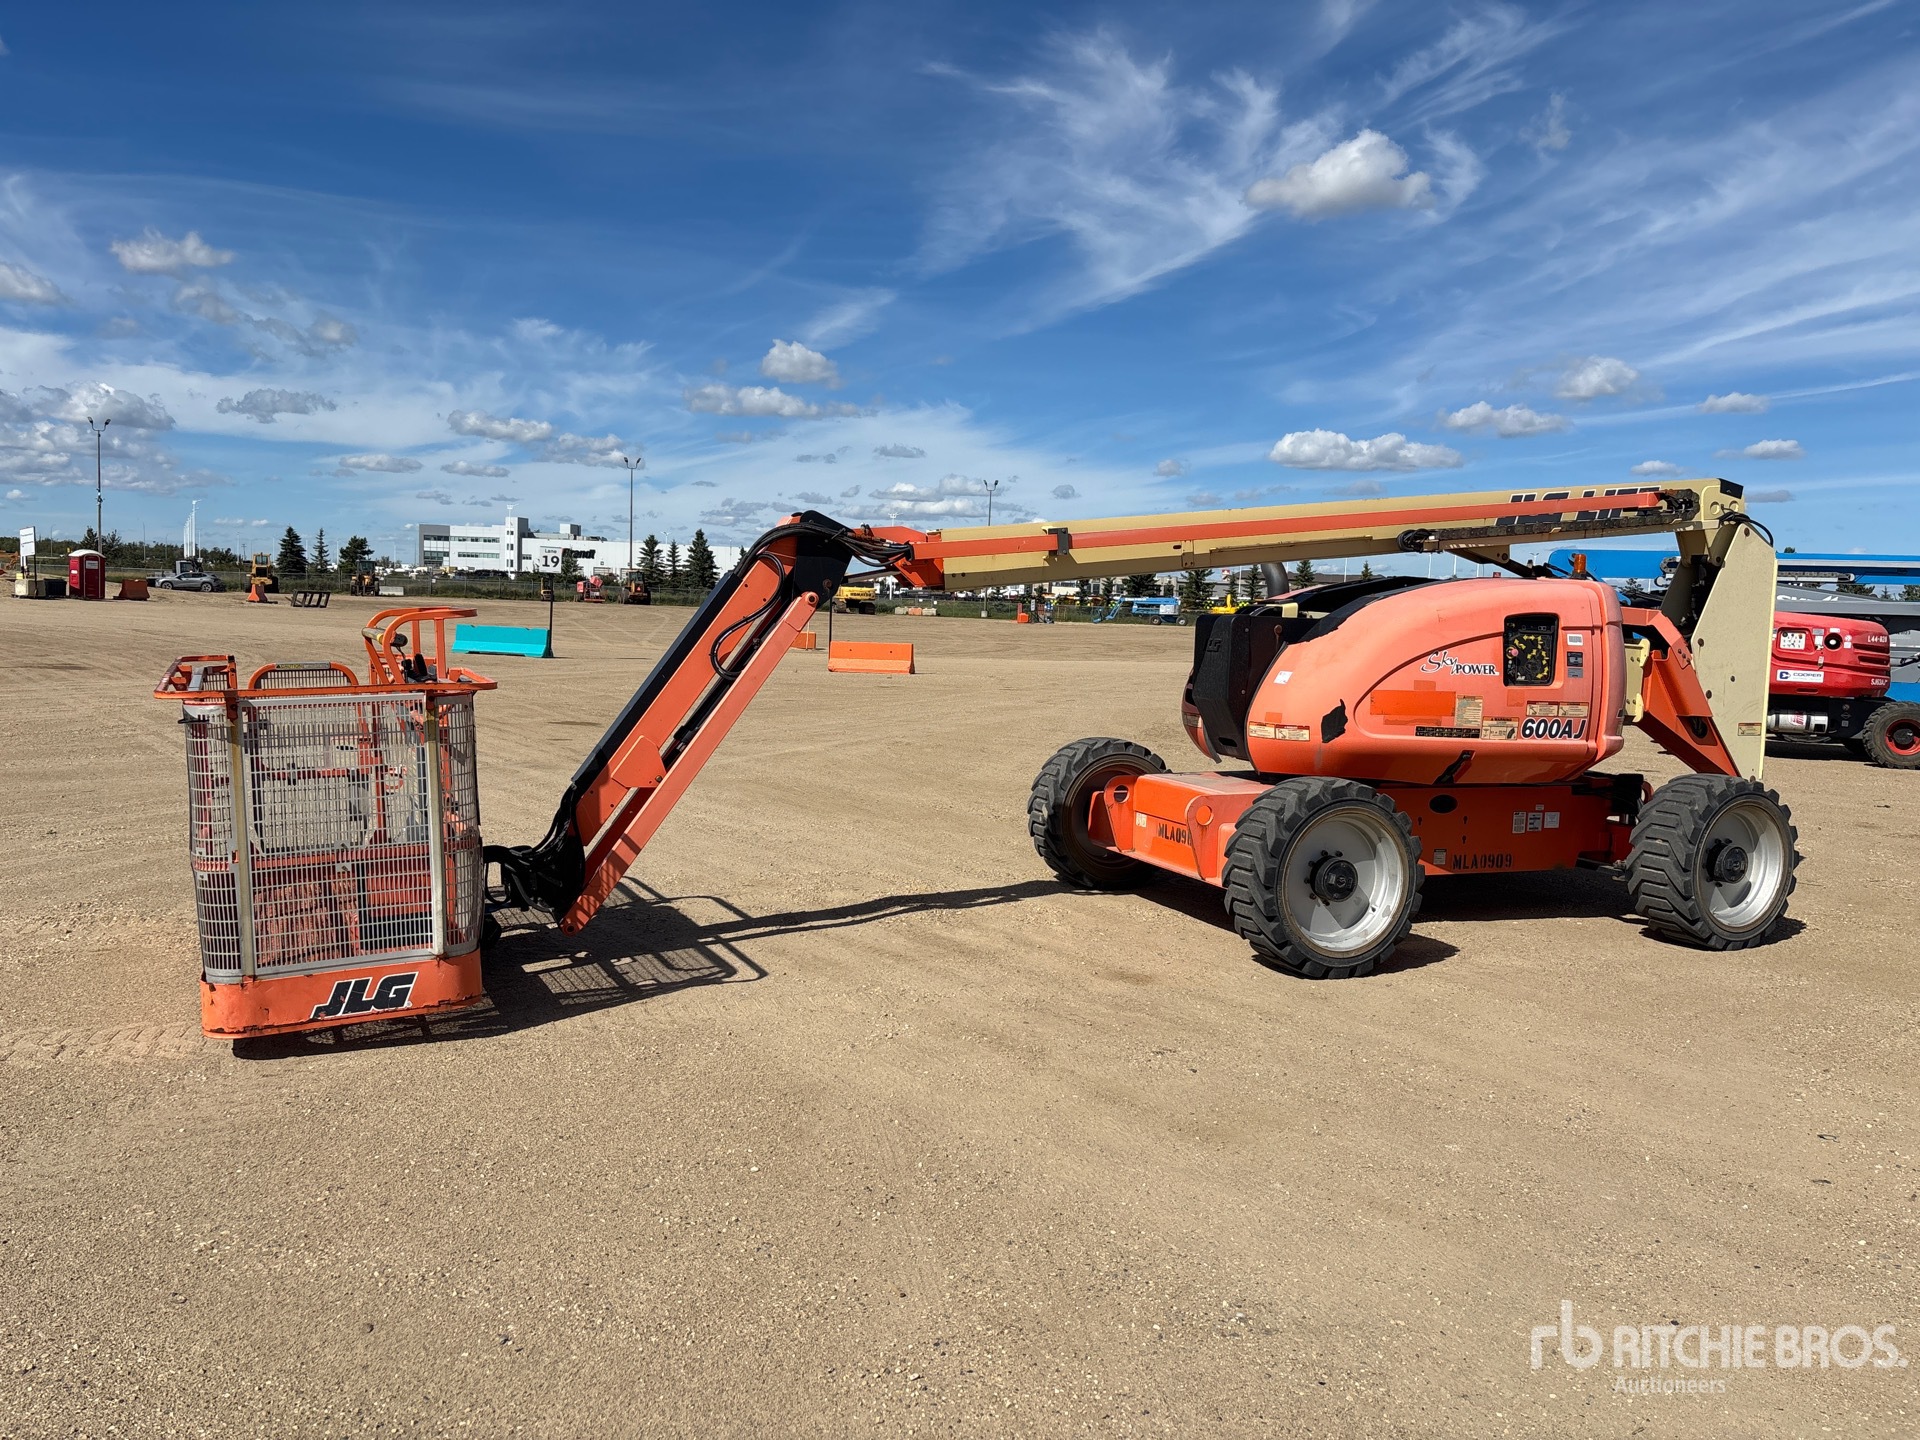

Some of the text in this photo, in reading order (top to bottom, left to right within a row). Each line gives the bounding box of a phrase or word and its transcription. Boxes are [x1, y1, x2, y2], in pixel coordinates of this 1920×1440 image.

[542, 556, 560, 568] 19
[1455, 663, 1497, 676] POWER
[1521, 717, 1587, 739] 600AJ
[1452, 854, 1512, 870] MLA0909
[310, 971, 419, 1020] JLG
